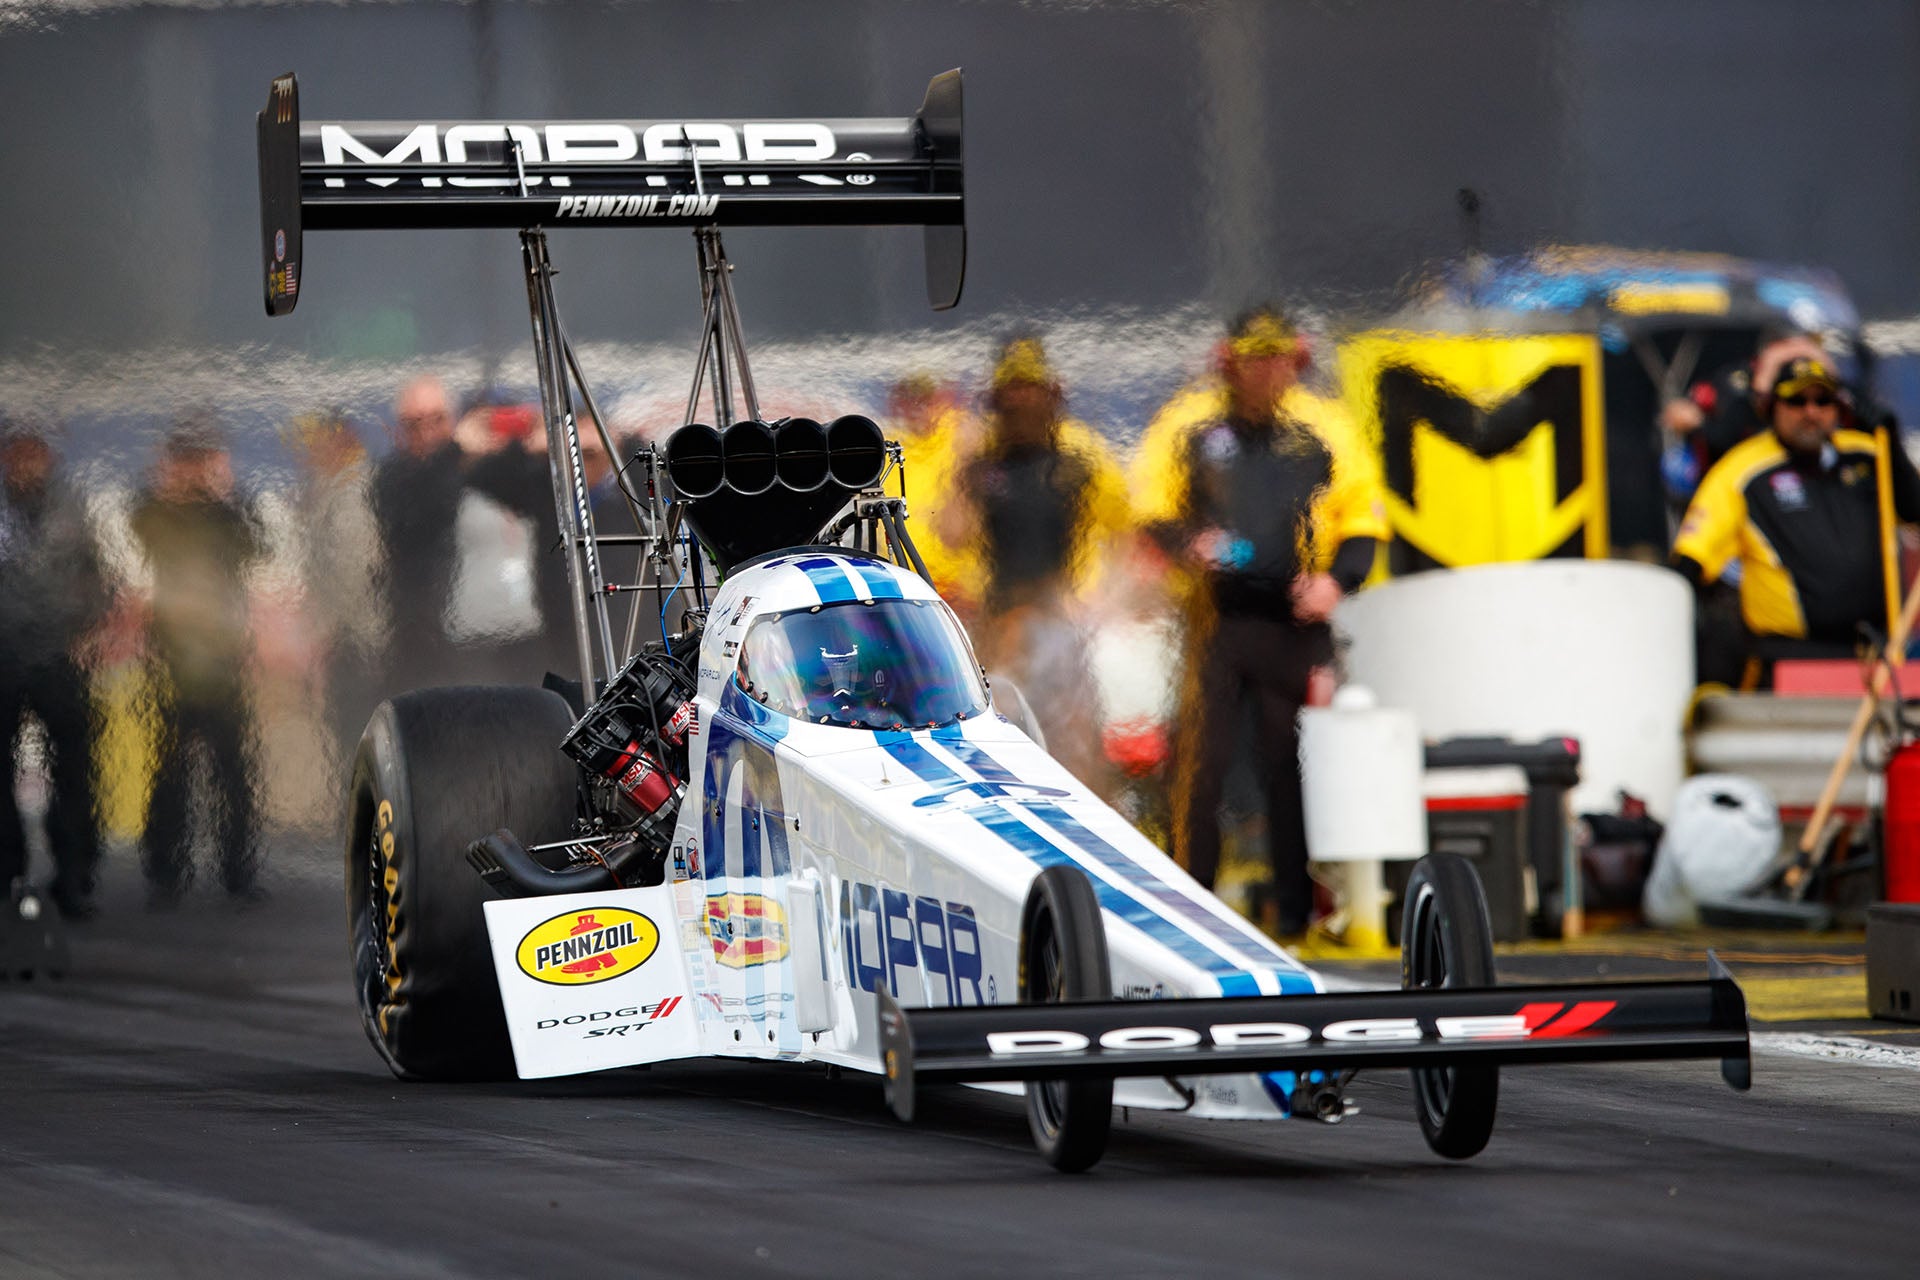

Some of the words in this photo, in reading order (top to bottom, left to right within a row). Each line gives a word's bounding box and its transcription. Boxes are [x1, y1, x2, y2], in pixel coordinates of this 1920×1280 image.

[320, 123, 845, 188] MOPAR
[554, 194, 721, 218] PENNZOIL.COM
[620, 761, 644, 787] MSD
[536, 922, 638, 971] PENNZOIL
[537, 1003, 662, 1030] DODGE
[582, 1021, 653, 1040] SRT
[986, 1014, 1532, 1056] DODGE
